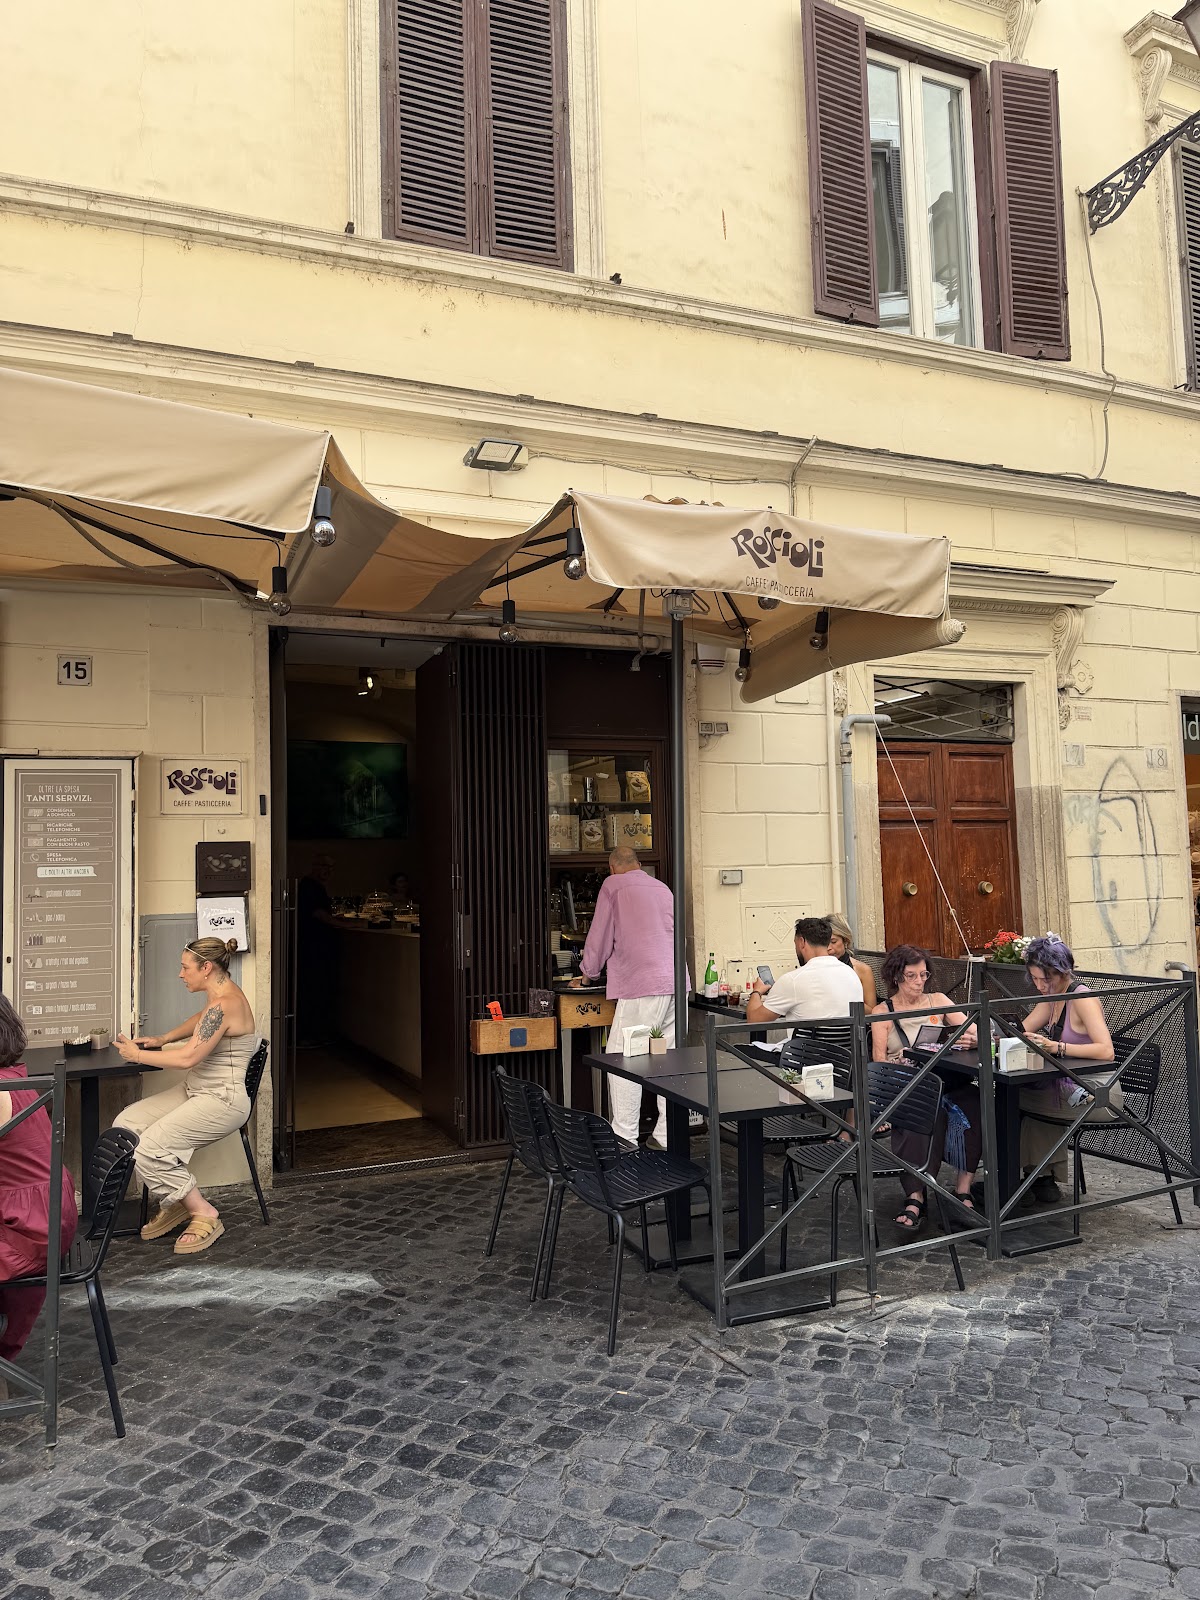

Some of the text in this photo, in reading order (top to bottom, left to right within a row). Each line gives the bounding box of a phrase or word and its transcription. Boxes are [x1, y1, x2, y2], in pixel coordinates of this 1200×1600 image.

[770, 580, 814, 598] PACCERIA
[63, 661, 87, 680] 15
[1148, 748, 1166, 767] 18
[26, 794, 92, 802] TANTI SERVIZI:
[38, 785, 80, 794] OLTRE LA SPESA
